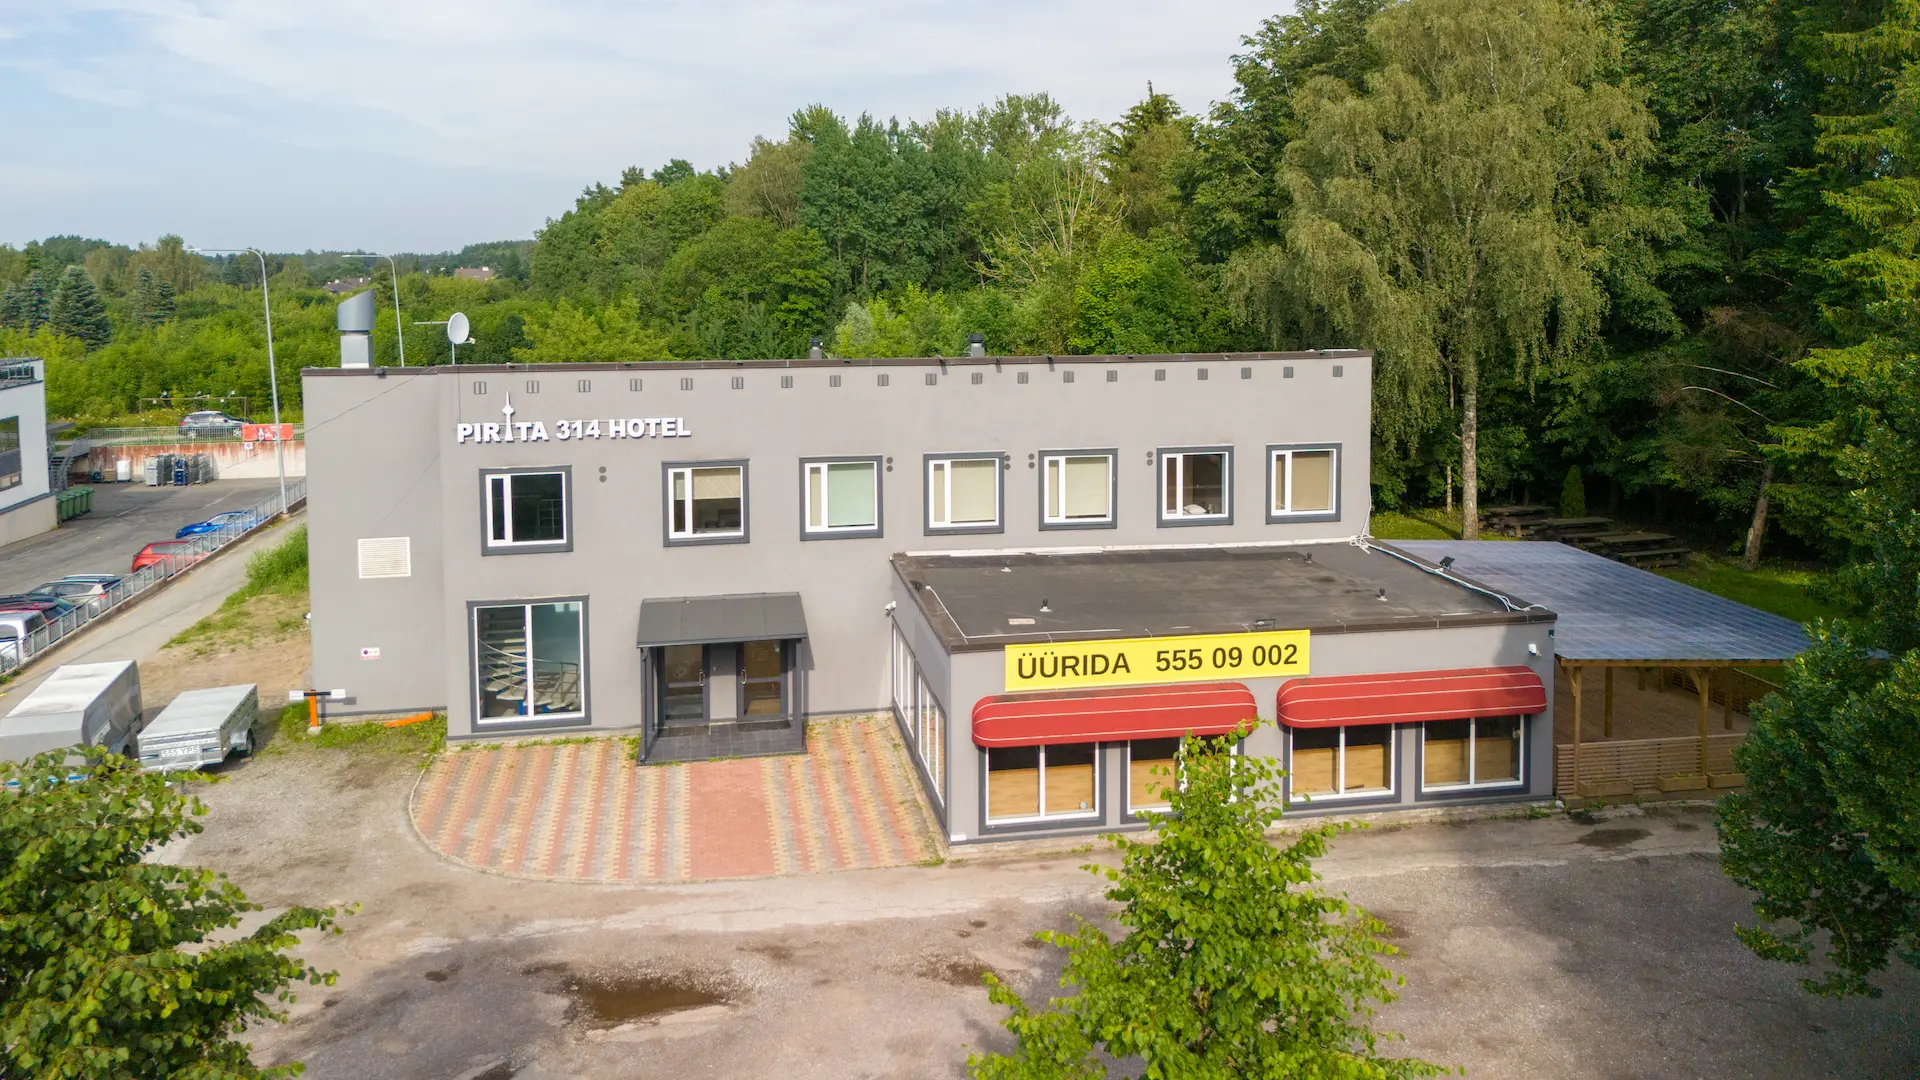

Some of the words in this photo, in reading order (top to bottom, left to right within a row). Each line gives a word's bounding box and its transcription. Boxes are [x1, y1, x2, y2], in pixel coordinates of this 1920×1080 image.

[556, 419, 601, 440] 314
[609, 417, 692, 438] HOTEL
[1017, 652, 1131, 679] ÜÜRIDA
[1156, 649, 1203, 672] 555
[1212, 646, 1243, 669] 09
[1252, 643, 1298, 667] 002
